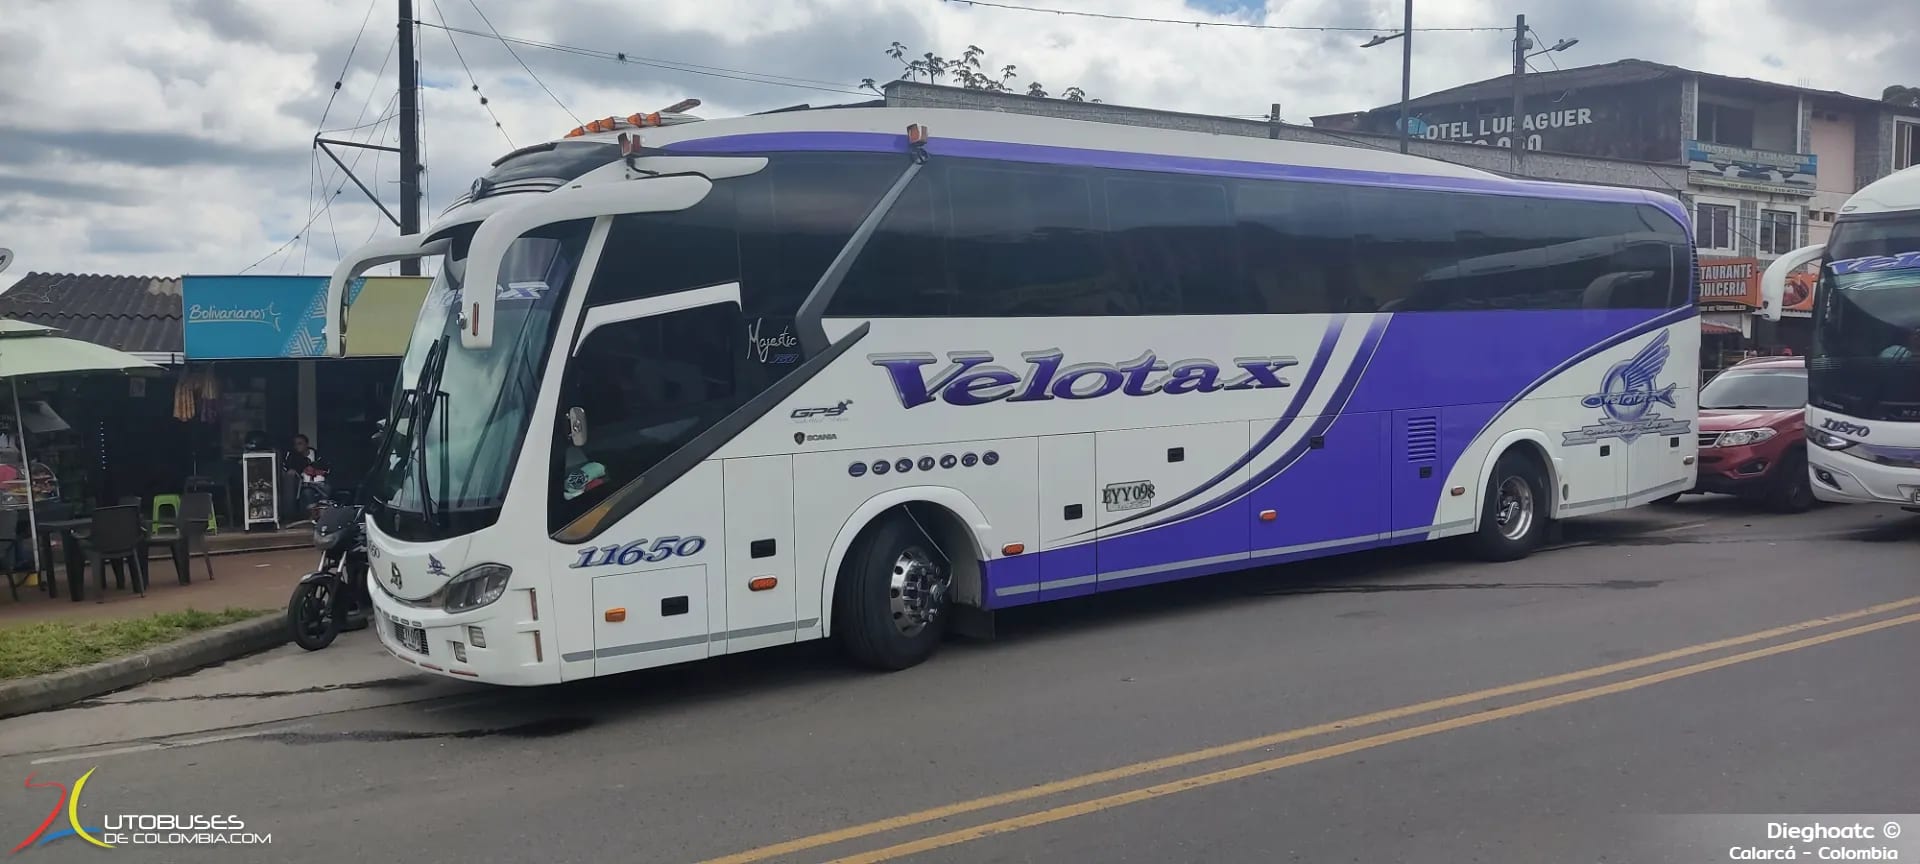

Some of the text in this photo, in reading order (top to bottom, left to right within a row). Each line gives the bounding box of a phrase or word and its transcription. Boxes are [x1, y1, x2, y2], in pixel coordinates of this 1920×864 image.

[746, 317, 798, 362] Majestic
[868, 348, 1298, 409] Velotax
[790, 406, 847, 418] GPS
[807, 434, 837, 442] SCANIA
[1820, 417, 1871, 437] 11870
[569, 536, 706, 568] 11650
